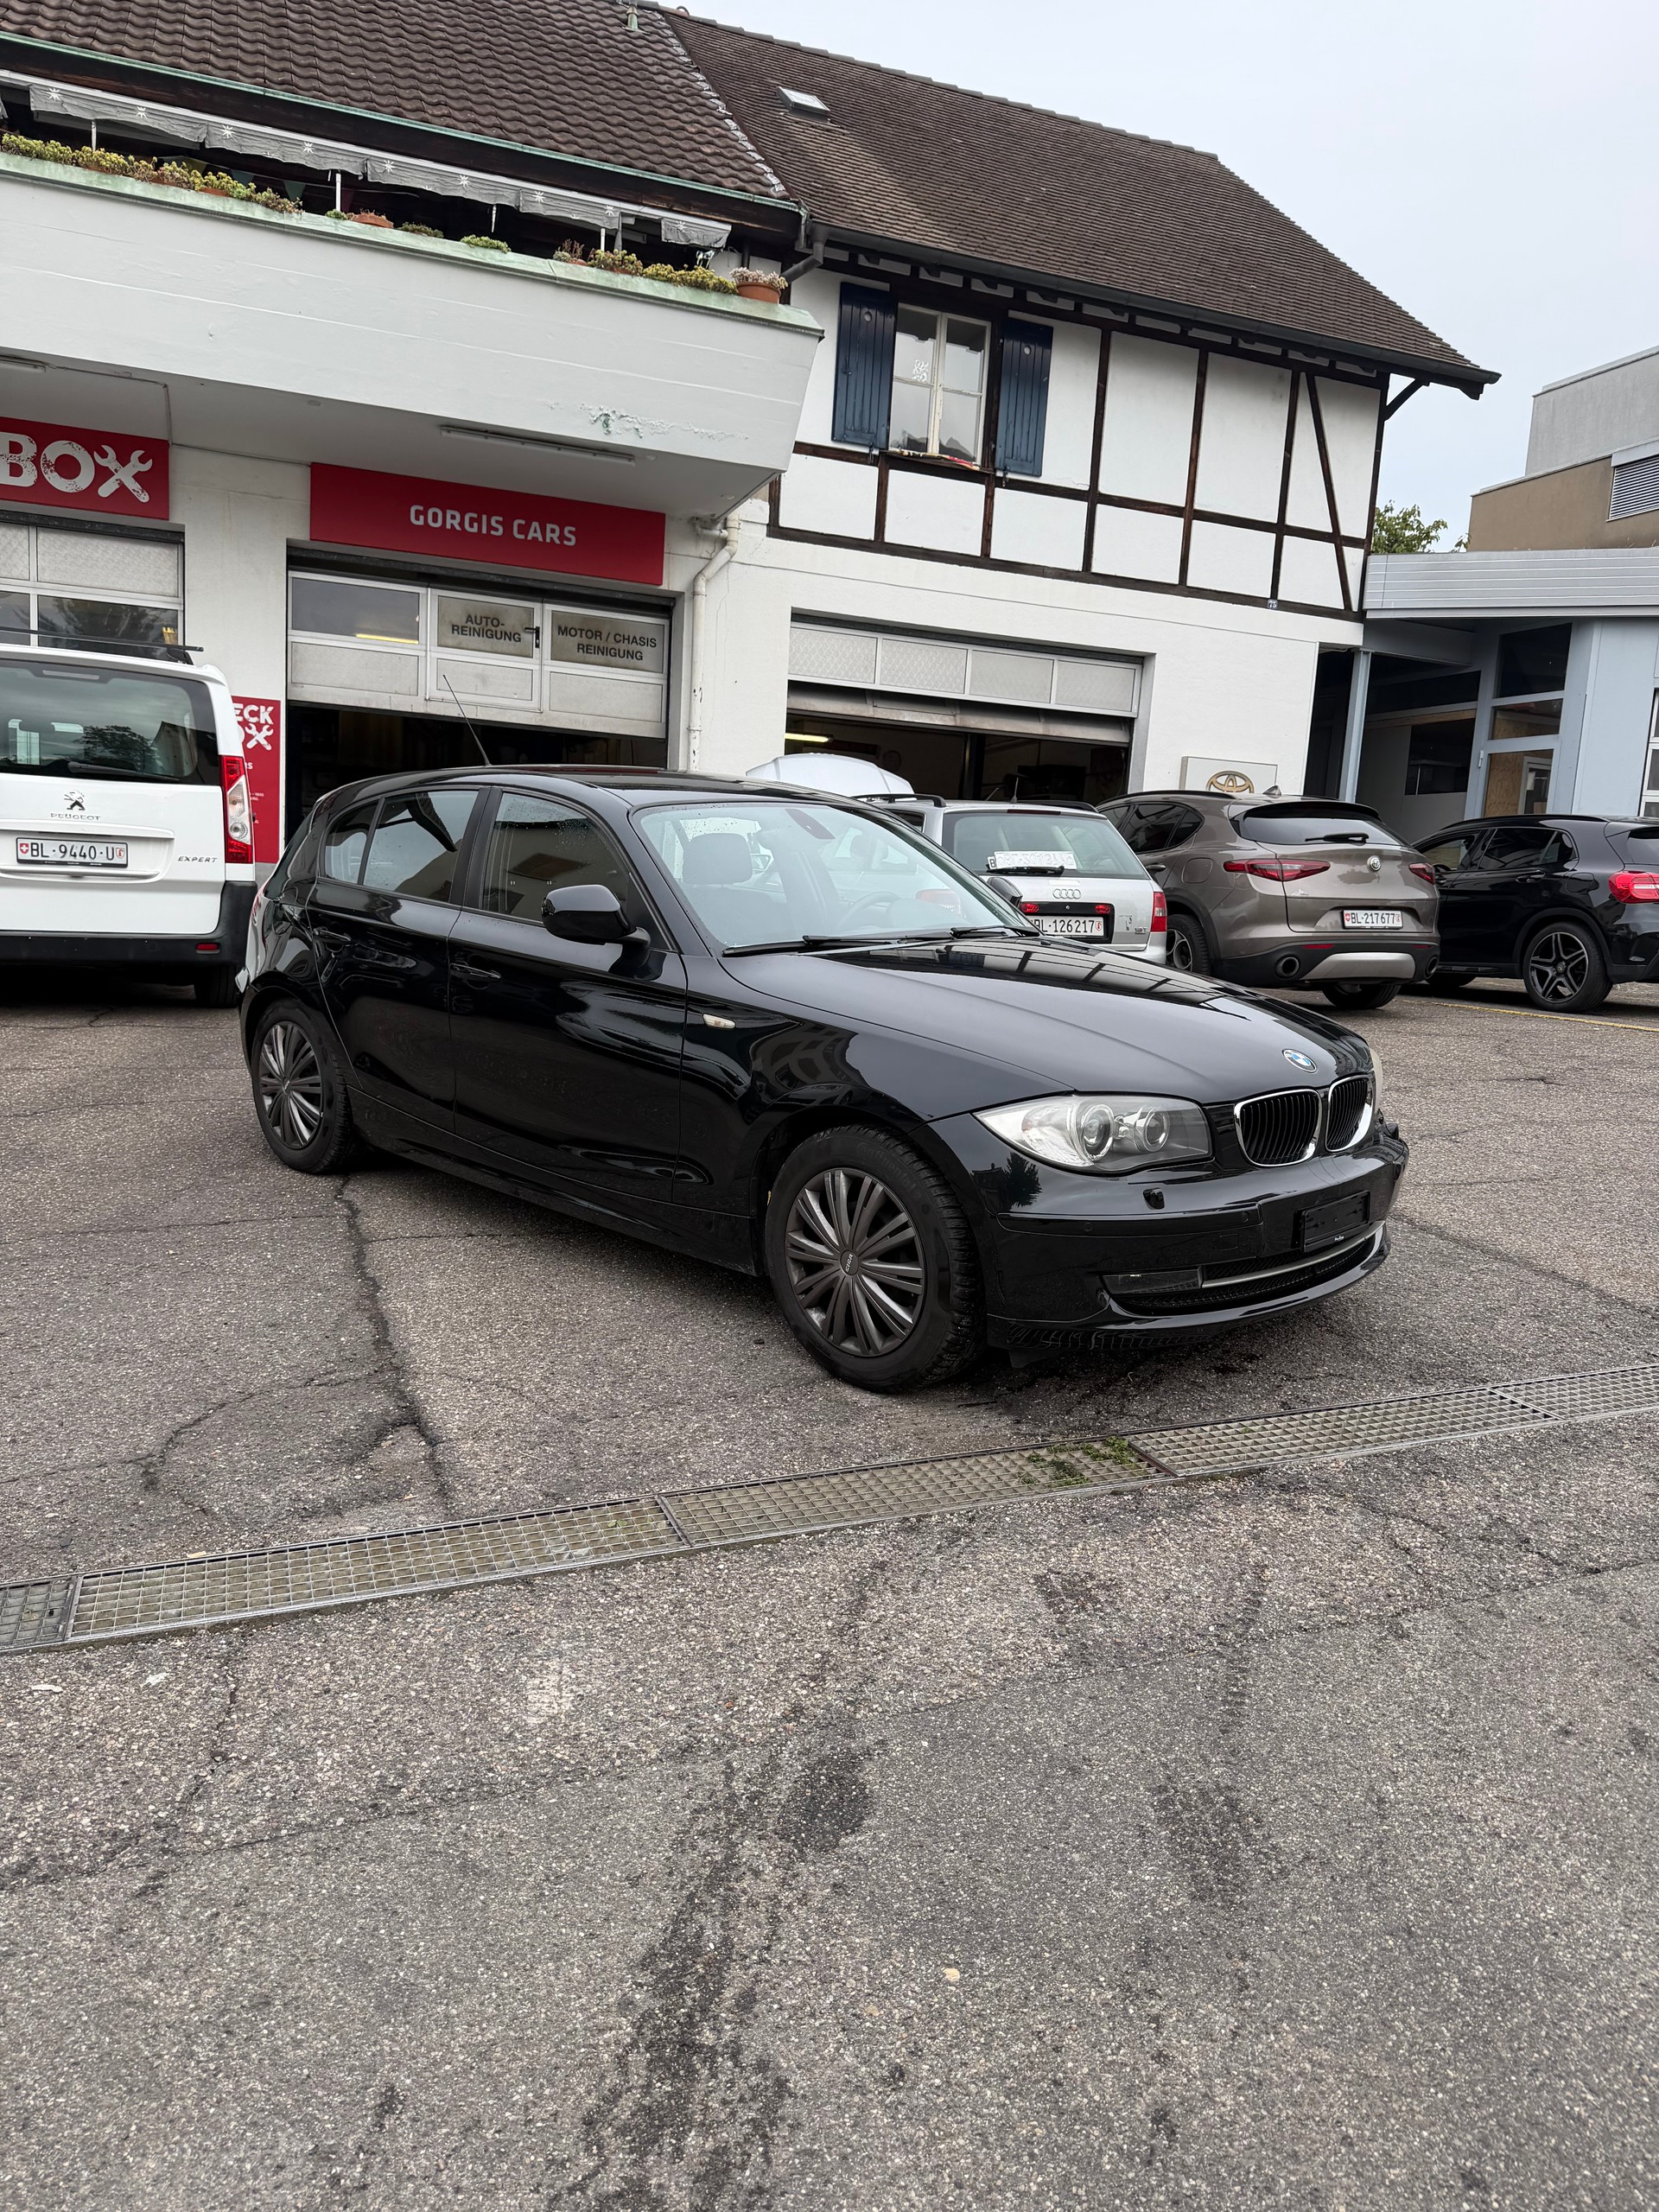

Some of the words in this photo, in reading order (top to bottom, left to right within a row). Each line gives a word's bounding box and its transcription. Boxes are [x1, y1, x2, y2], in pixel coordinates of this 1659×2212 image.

[410, 505, 504, 537] GORGIS
[512, 518, 576, 547] CARS
[465, 614, 505, 628] AUTO-
[451, 624, 522, 643] REINIGUNG
[557, 626, 602, 641] MOTOR
[606, 632, 611, 642] /
[613, 632, 657, 648] CHASIS
[577, 643, 644, 661] REINIGUNG
[50, 812, 101, 821] PEUGEOT
